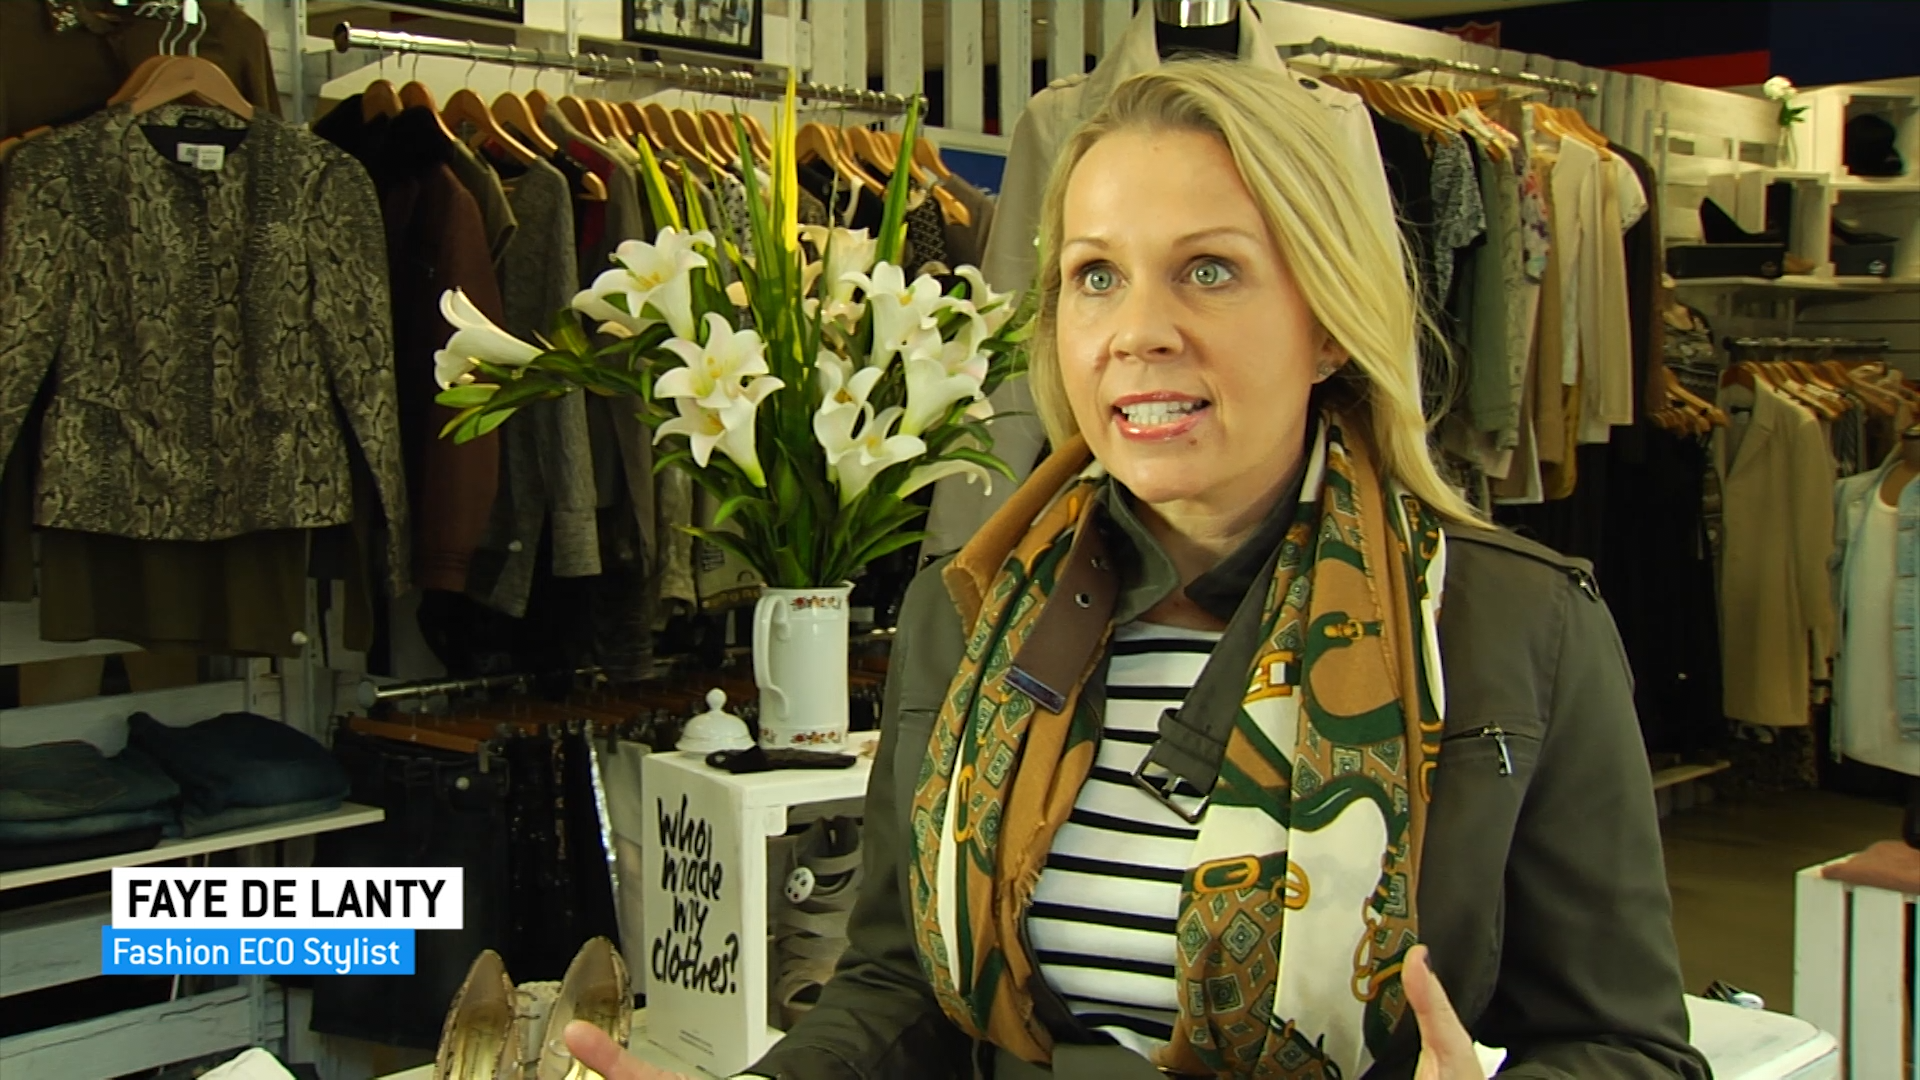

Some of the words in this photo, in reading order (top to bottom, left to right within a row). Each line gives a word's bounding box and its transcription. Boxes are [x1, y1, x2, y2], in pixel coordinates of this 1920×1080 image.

[662, 825, 723, 900] made
[673, 895, 709, 947] my
[651, 927, 740, 996] clothes?
